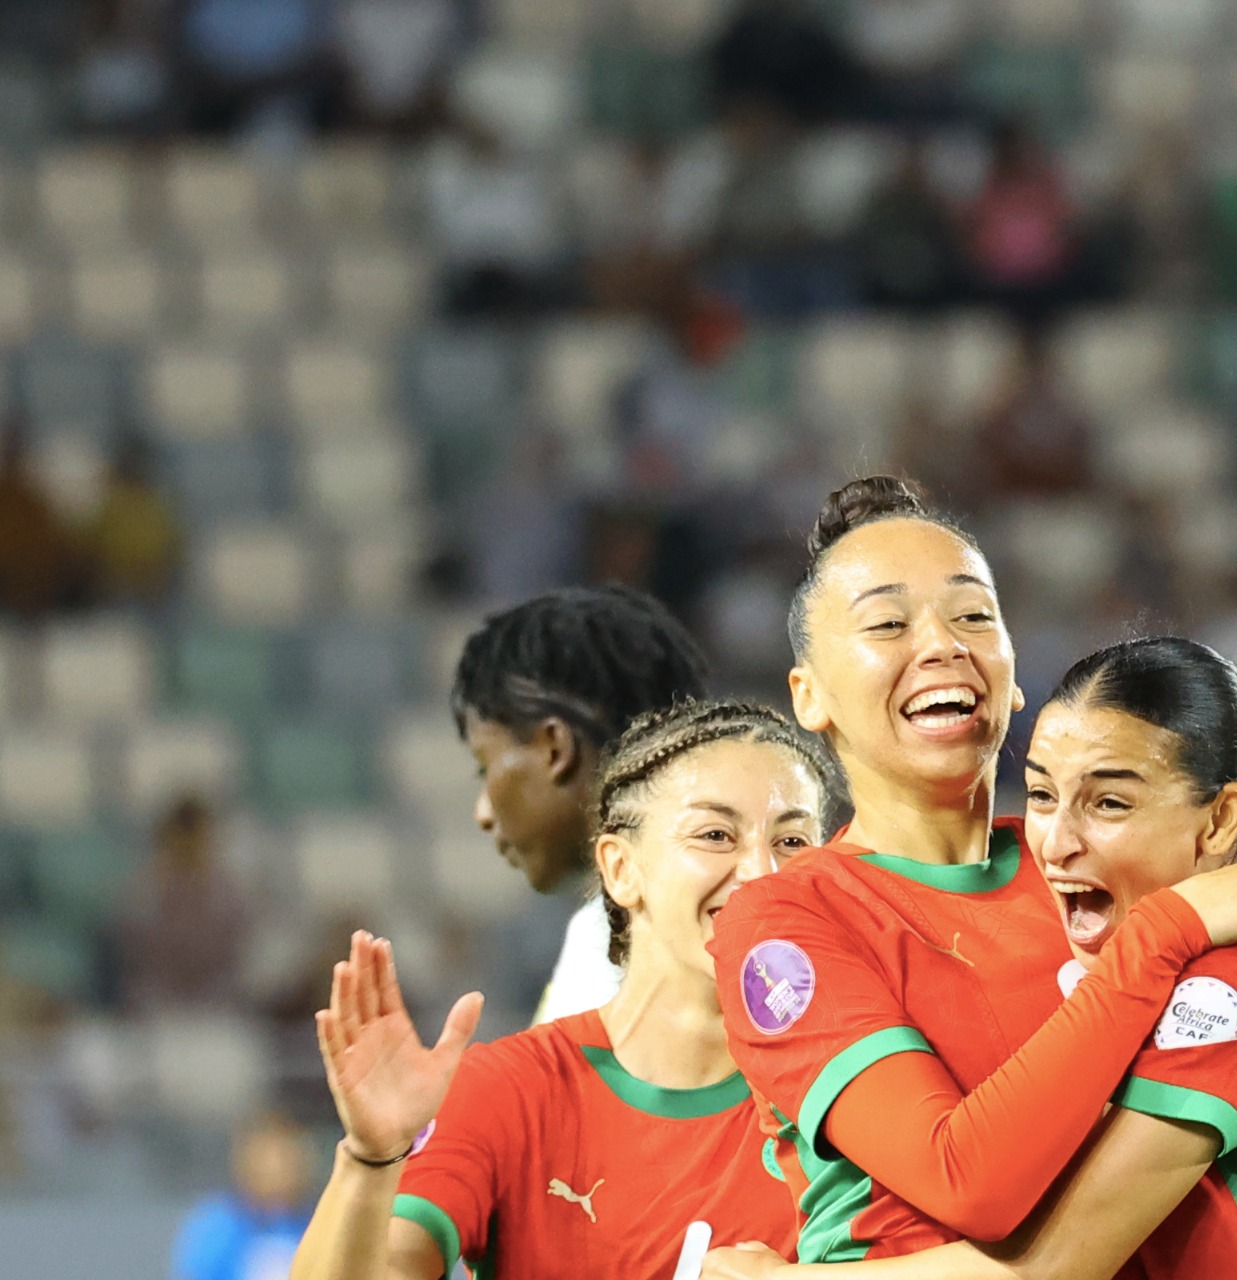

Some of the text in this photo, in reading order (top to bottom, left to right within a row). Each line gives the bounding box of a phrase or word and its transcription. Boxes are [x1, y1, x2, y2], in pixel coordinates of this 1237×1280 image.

[1172, 1001, 1230, 1026] Celebrate
[1176, 1013, 1214, 1032] Africa
[1175, 1026, 1209, 1041] CAF
